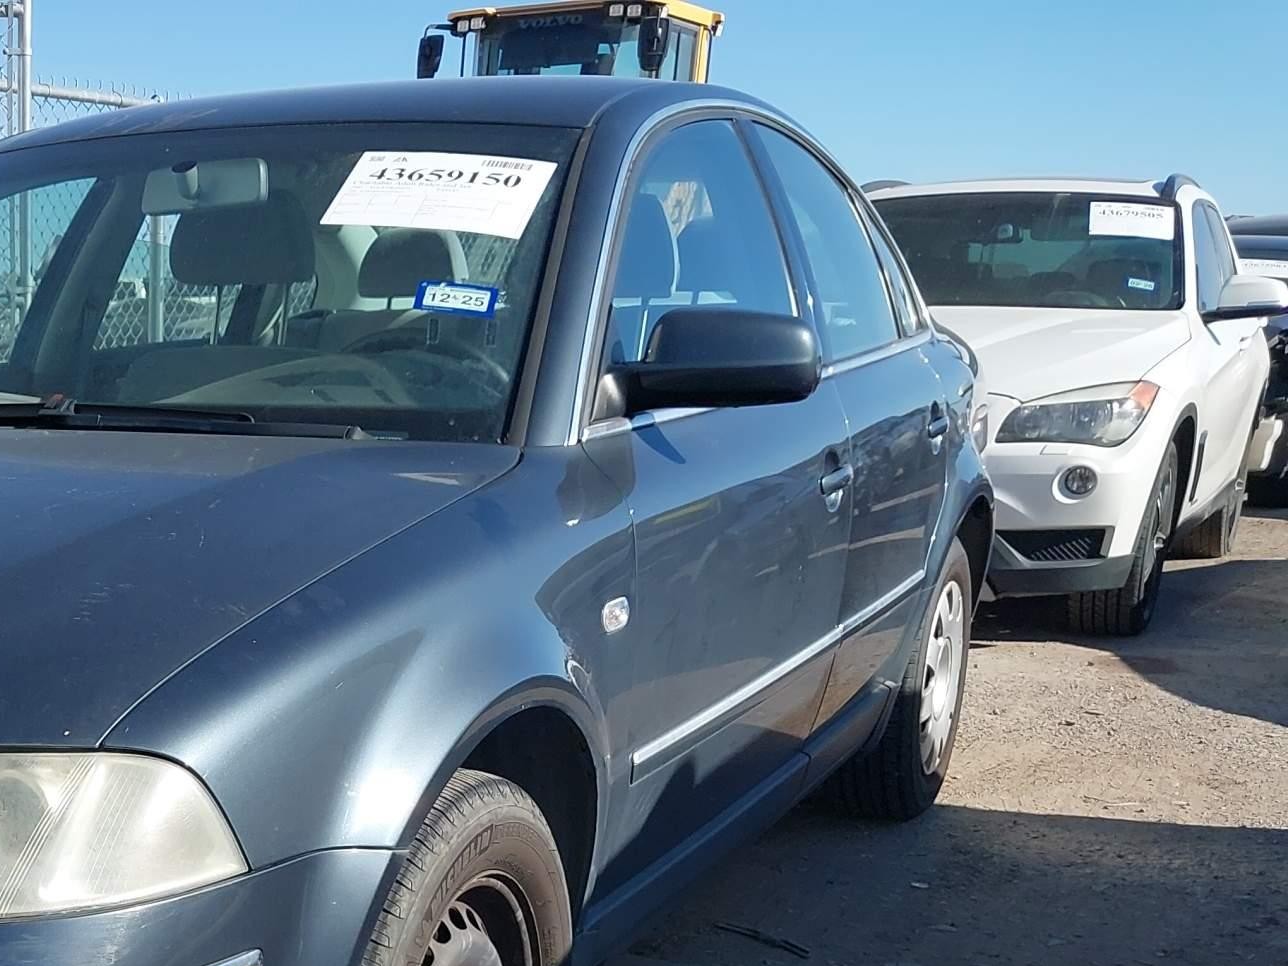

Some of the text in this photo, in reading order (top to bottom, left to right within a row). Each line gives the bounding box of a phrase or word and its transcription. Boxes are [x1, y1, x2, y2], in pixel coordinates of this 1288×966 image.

[519, 14, 583, 29] VOLVO
[369, 167, 522, 188] 43659150
[429, 292, 485, 307] 12 25
